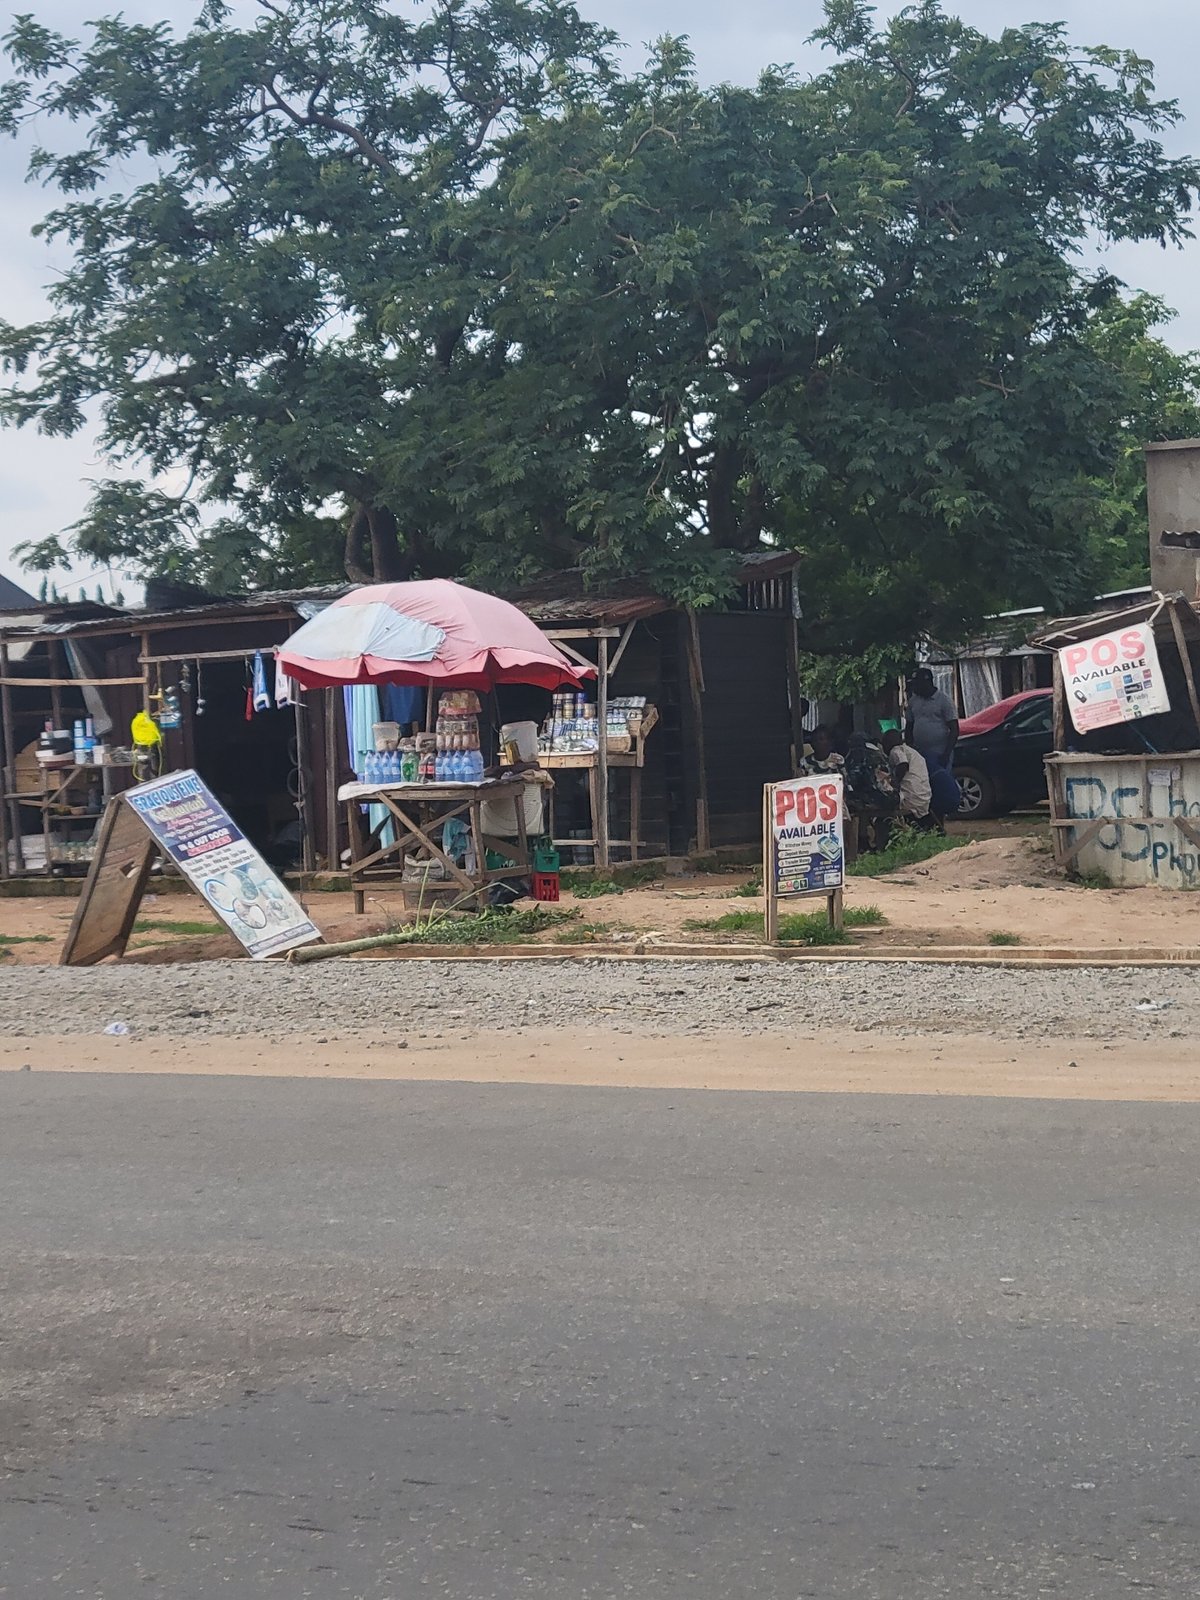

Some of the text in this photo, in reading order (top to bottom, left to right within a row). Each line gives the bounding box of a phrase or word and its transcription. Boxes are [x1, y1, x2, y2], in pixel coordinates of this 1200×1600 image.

[1065, 631, 1146, 676] POS
[1072, 658, 1146, 685] AVAILABLE
[775, 783, 838, 827] POS
[192, 834, 210, 846] OUT
[206, 827, 230, 840] DOOR
[779, 822, 836, 840] AVAILABLE
